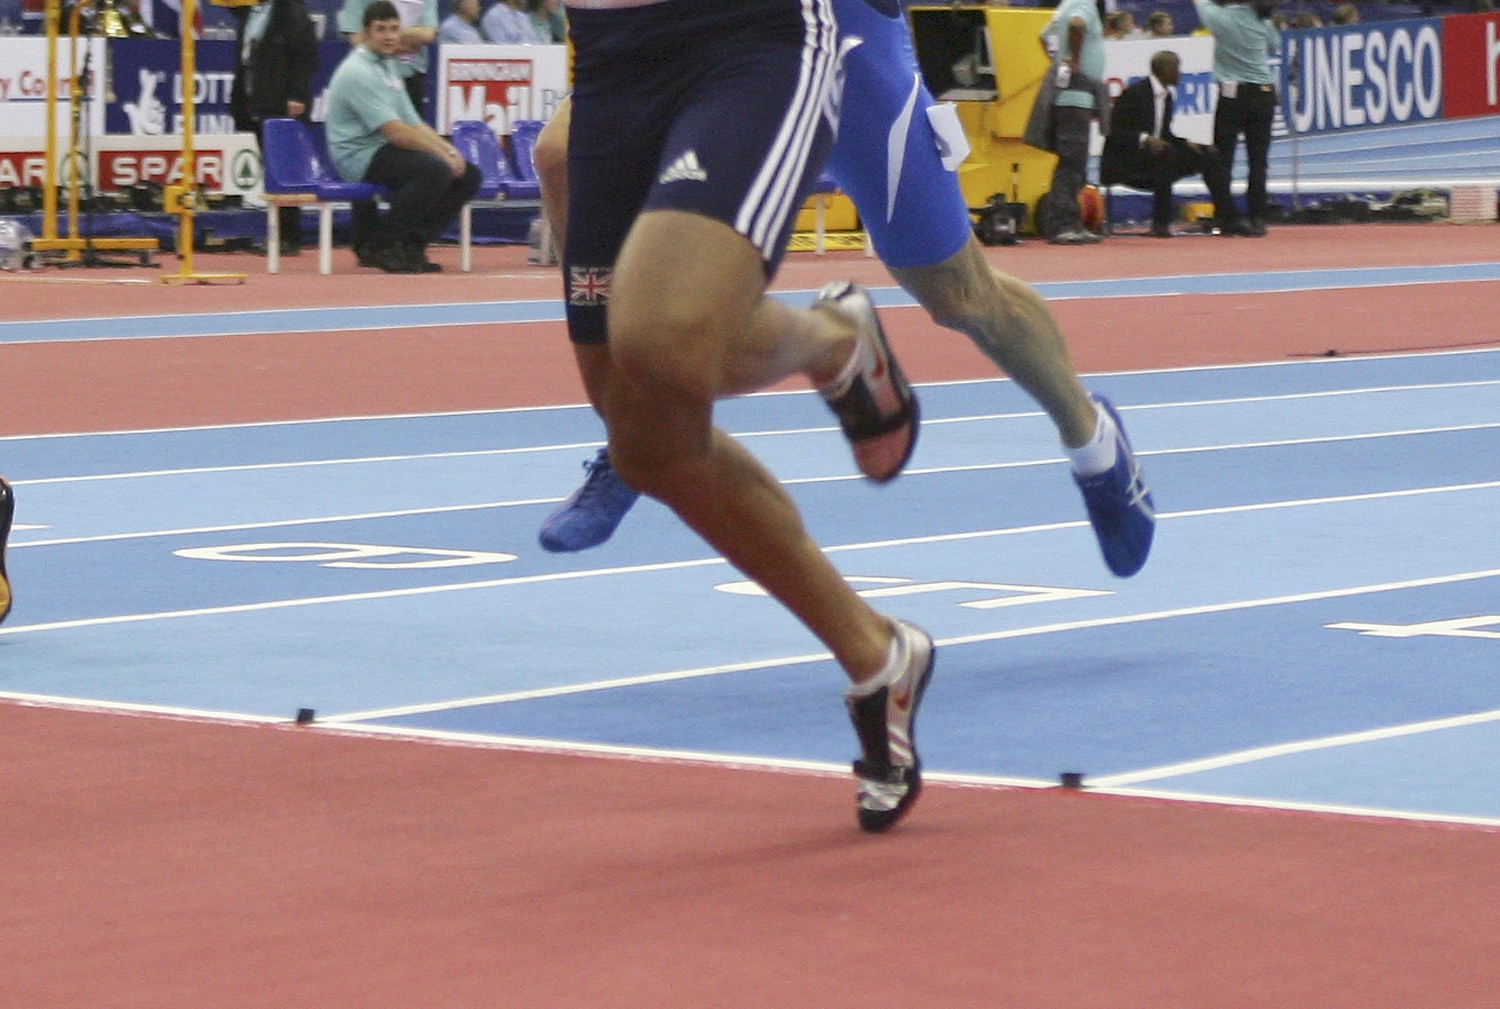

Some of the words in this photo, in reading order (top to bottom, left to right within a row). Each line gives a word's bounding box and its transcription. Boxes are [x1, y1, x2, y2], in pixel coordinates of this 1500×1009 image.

[19, 68, 94, 97] Conl
[173, 71, 236, 105] LOTT
[1288, 25, 1443, 133] UNESCO
[448, 84, 530, 135] Mail
[111, 155, 223, 188] SPAR
